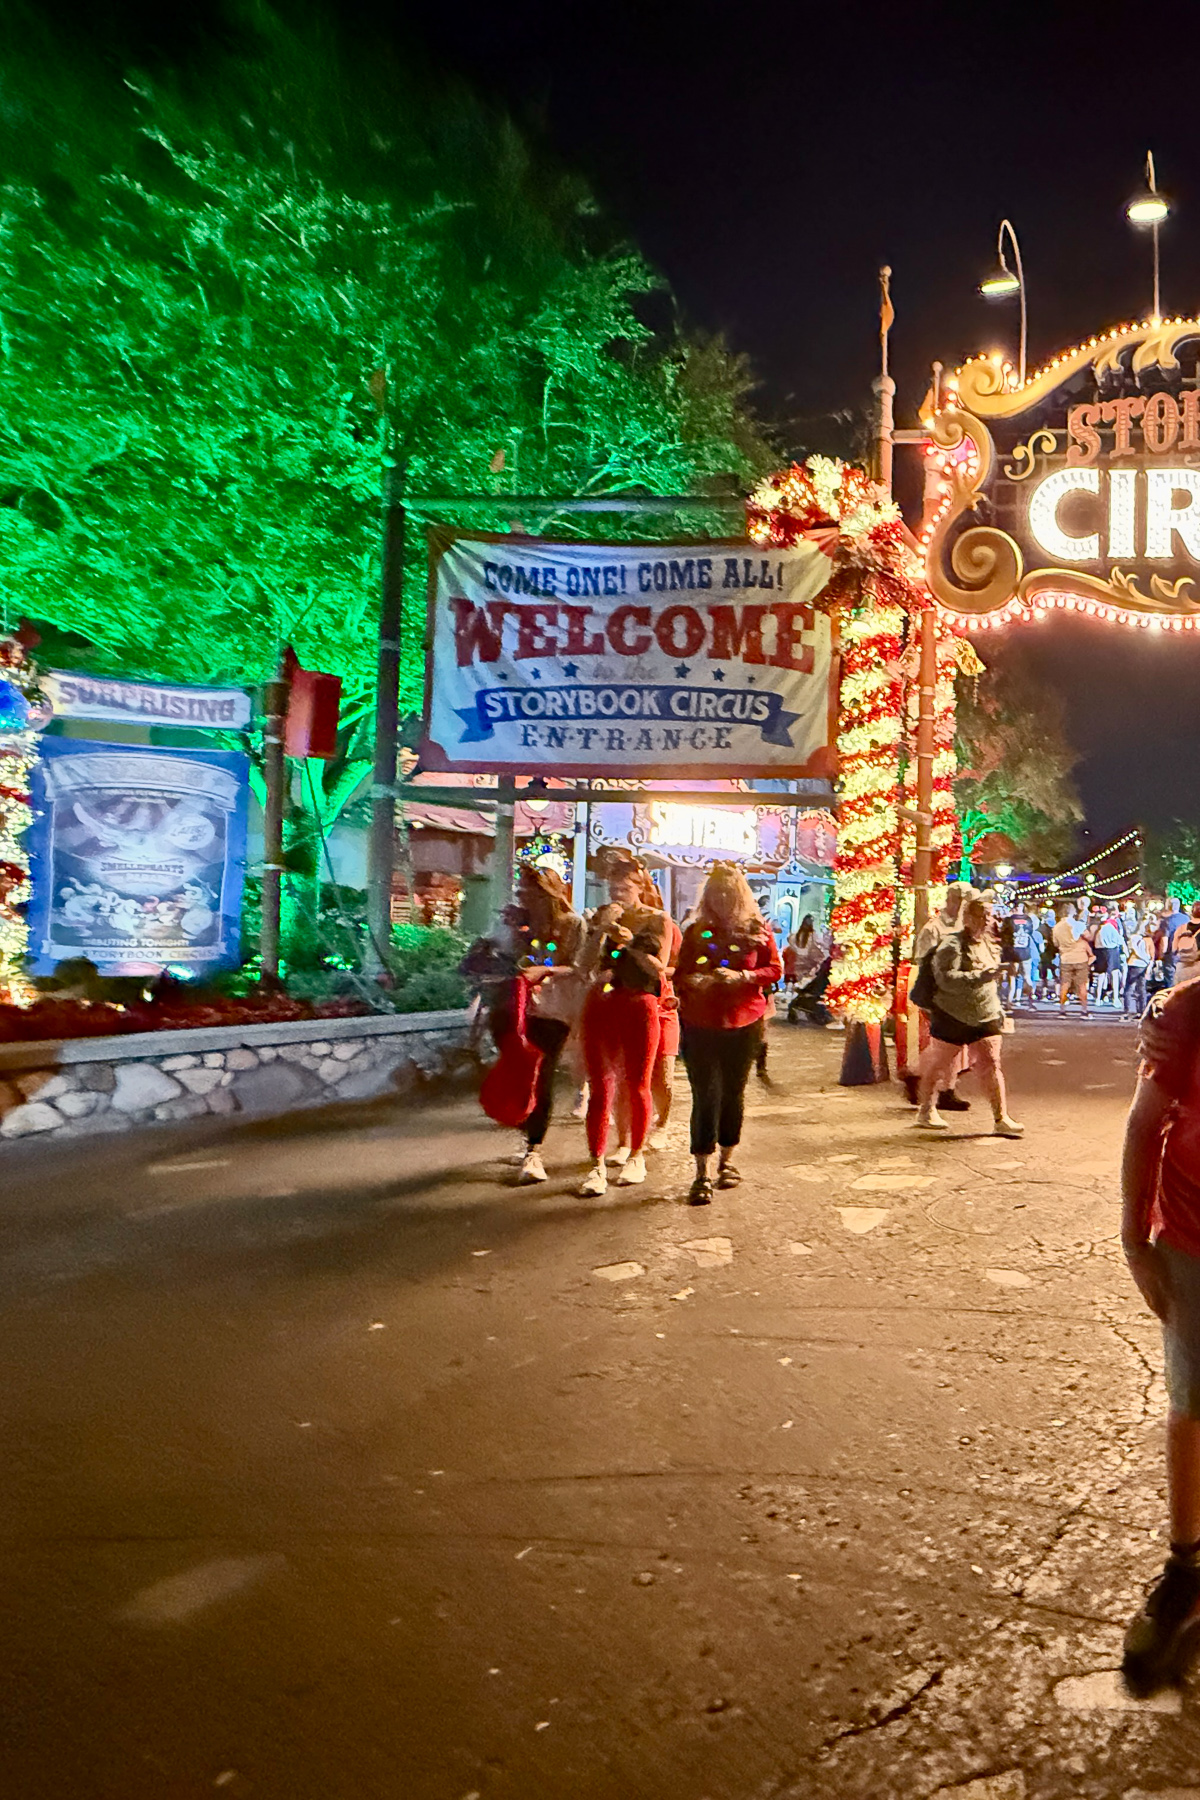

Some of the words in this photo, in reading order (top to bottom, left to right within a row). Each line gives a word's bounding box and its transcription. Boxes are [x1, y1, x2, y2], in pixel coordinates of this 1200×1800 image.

[484, 561, 564, 596] COME
[566, 564, 627, 596] ONE!
[638, 560, 711, 591] COME
[723, 559, 785, 591] ALL!
[451, 599, 815, 674] WELCOME
[59, 681, 235, 722] SURPRISING
[485, 689, 660, 718] STORYBOOK
[670, 690, 770, 721] CIRCUS
